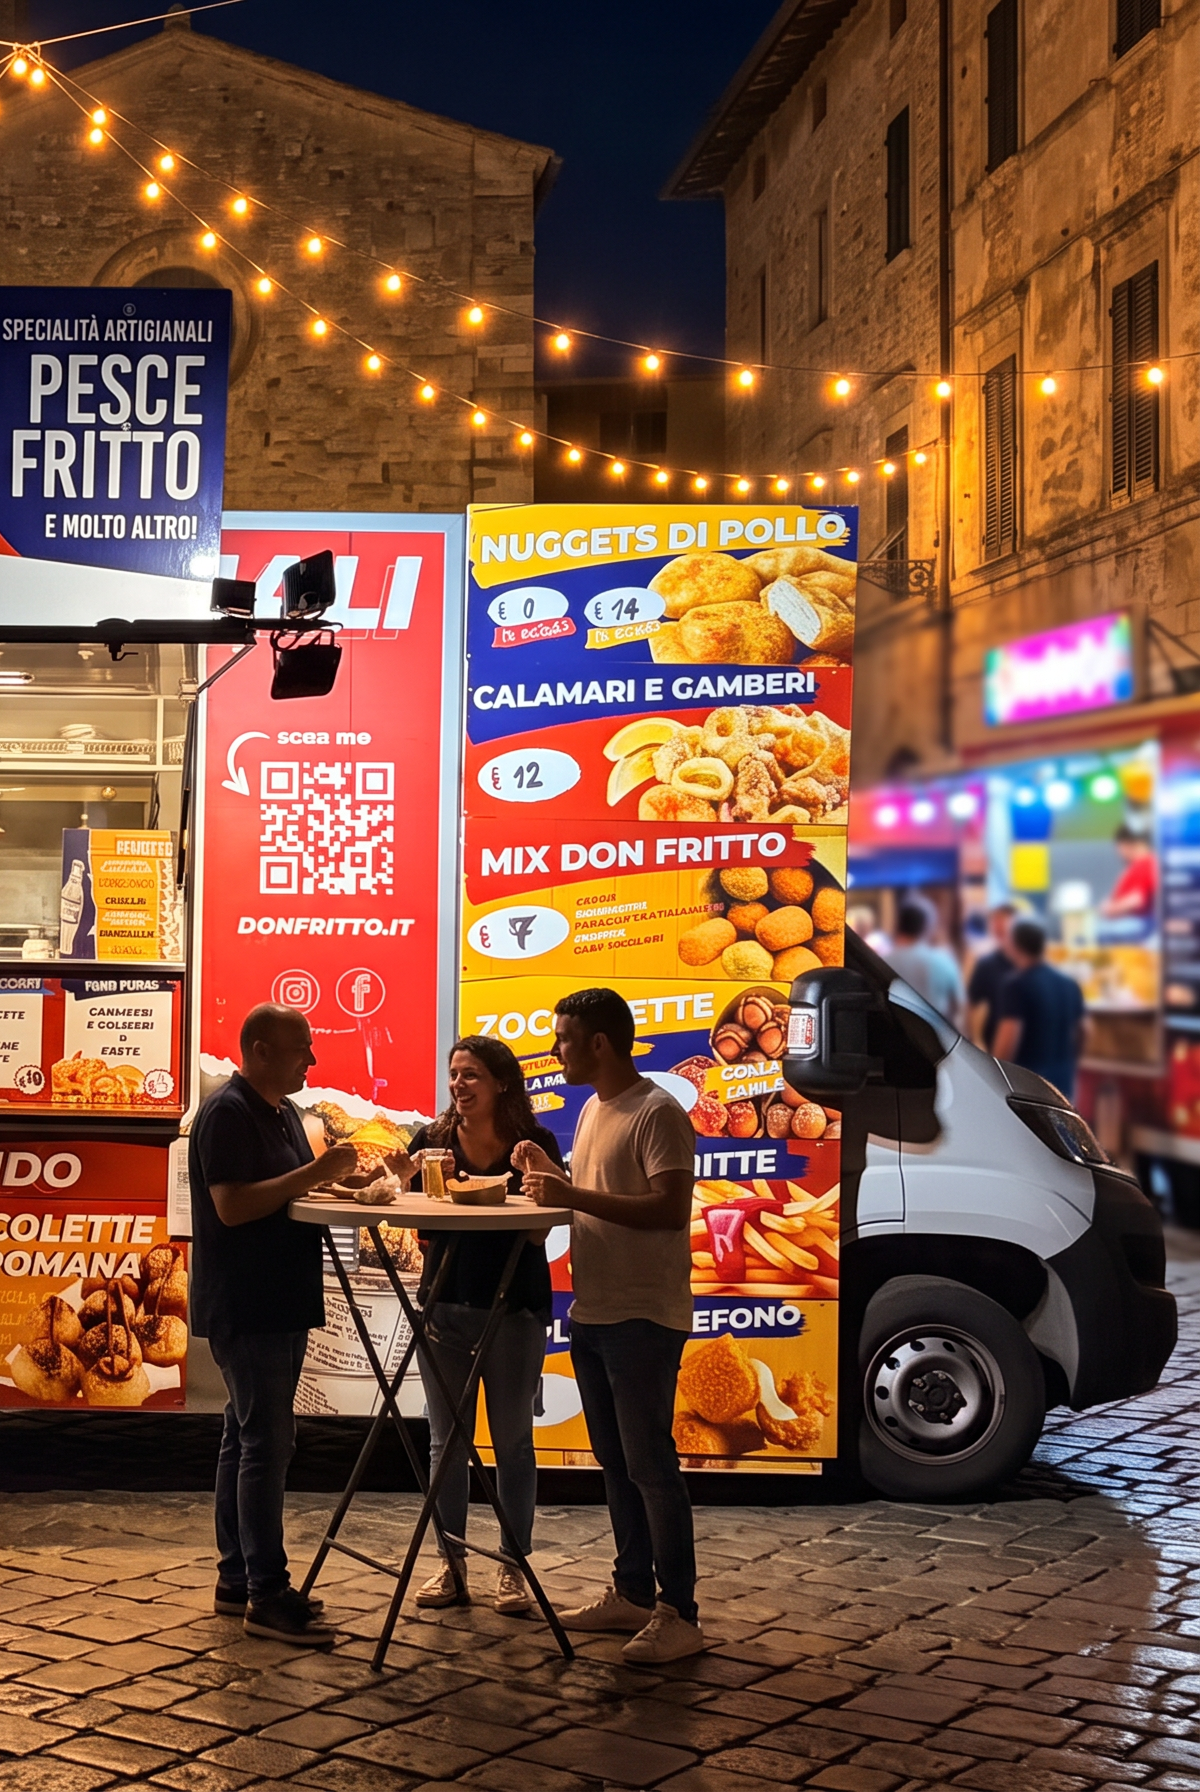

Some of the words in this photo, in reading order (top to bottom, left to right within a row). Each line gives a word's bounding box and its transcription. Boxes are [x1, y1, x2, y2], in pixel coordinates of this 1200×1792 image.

[2, 315, 99, 341] SPECIALITÀ
[104, 320, 213, 342] ARTIGIANALI
[30, 354, 205, 425] PESCE
[11, 429, 200, 500] FRITTO
[45, 514, 57, 538] E
[63, 514, 126, 539] MOLTO
[131, 515, 198, 540] ALTRO!
[481, 525, 658, 563] NUGGETS
[668, 522, 708, 549] DI
[719, 513, 847, 545] POLLO
[611, 597, 640, 620] 14
[473, 679, 635, 710] CALAMARI
[645, 678, 664, 700] E
[672, 672, 815, 699] GAMBERI
[336, 732, 372, 745] me
[513, 761, 543, 789] 12
[481, 845, 550, 876] MIX
[560, 839, 644, 871] DON
[656, 831, 786, 865] FRITTO
[237, 917, 415, 936] DONFRITTO.IT
[509, 915, 536, 950] 7
[87, 1021, 94, 1029] E
[692, 1304, 801, 1333] EFONO
